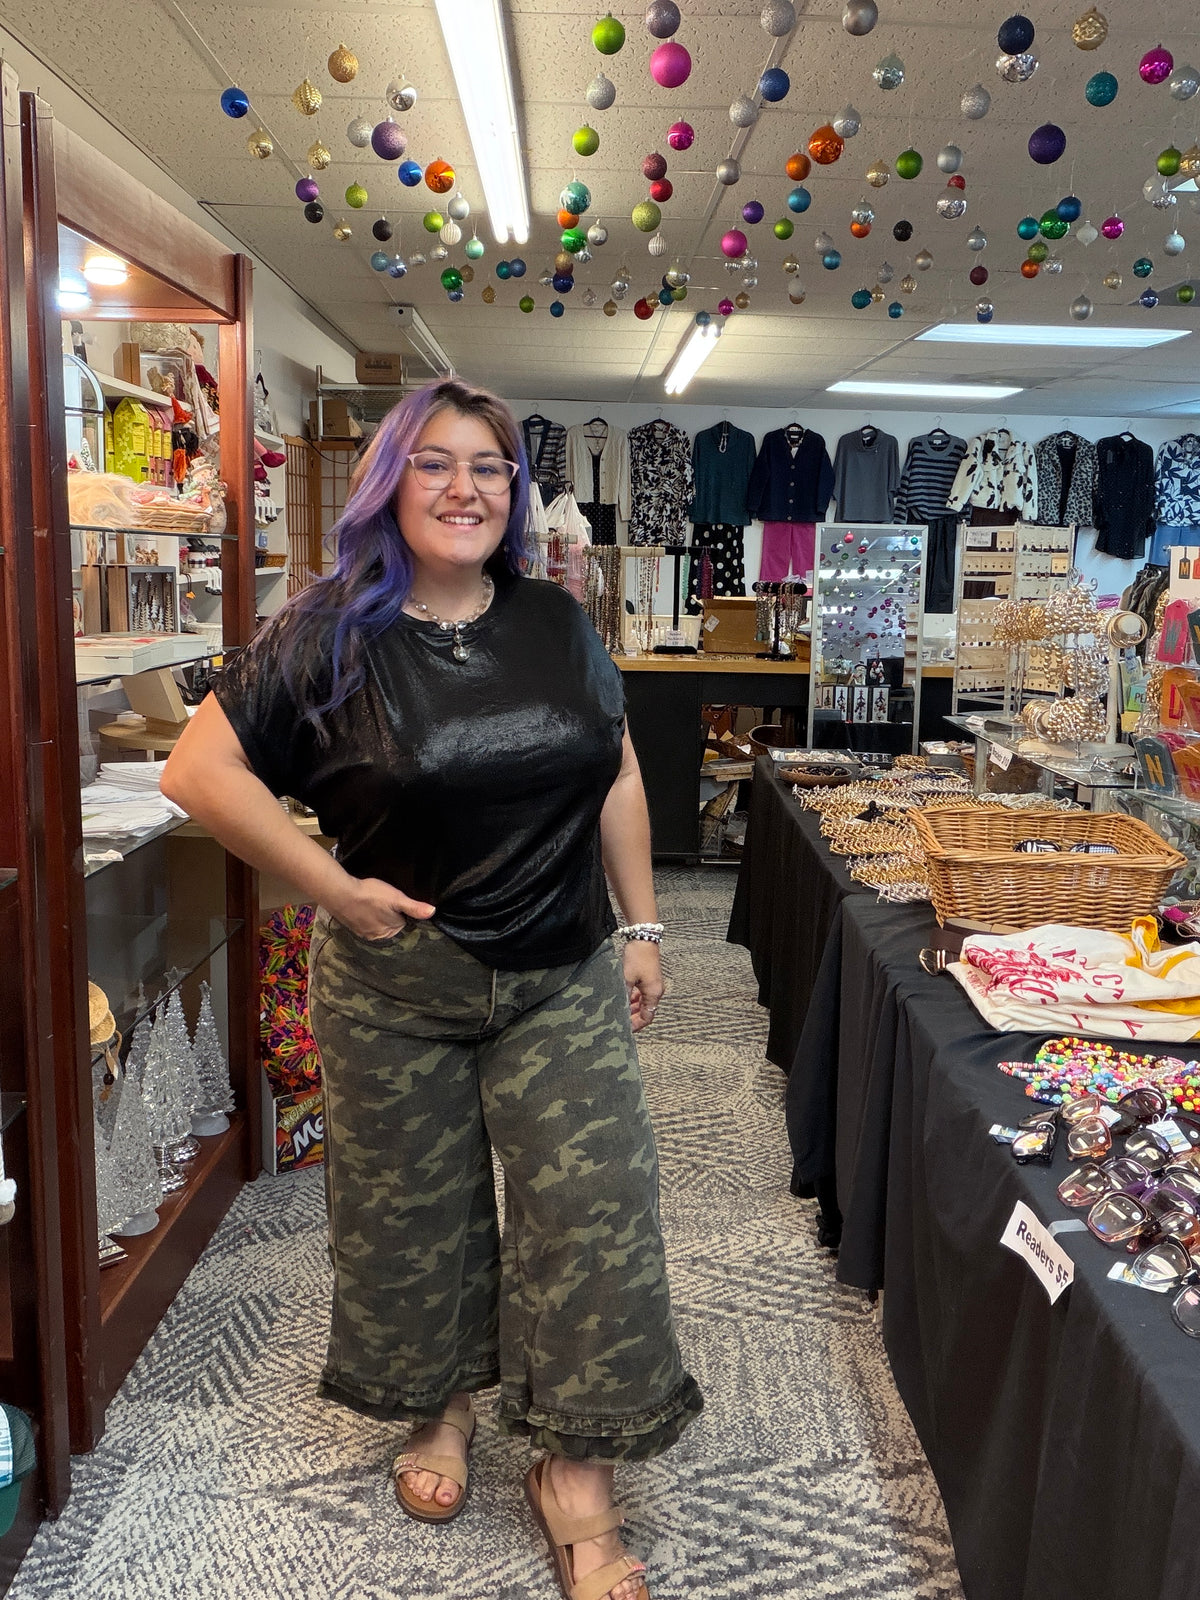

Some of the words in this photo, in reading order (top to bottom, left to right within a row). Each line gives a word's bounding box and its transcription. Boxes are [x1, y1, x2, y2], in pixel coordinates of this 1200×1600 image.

[1145, 753, 1166, 788] N
[1016, 1220, 1055, 1274] Readers
[1055, 1263, 1069, 1288] $5
